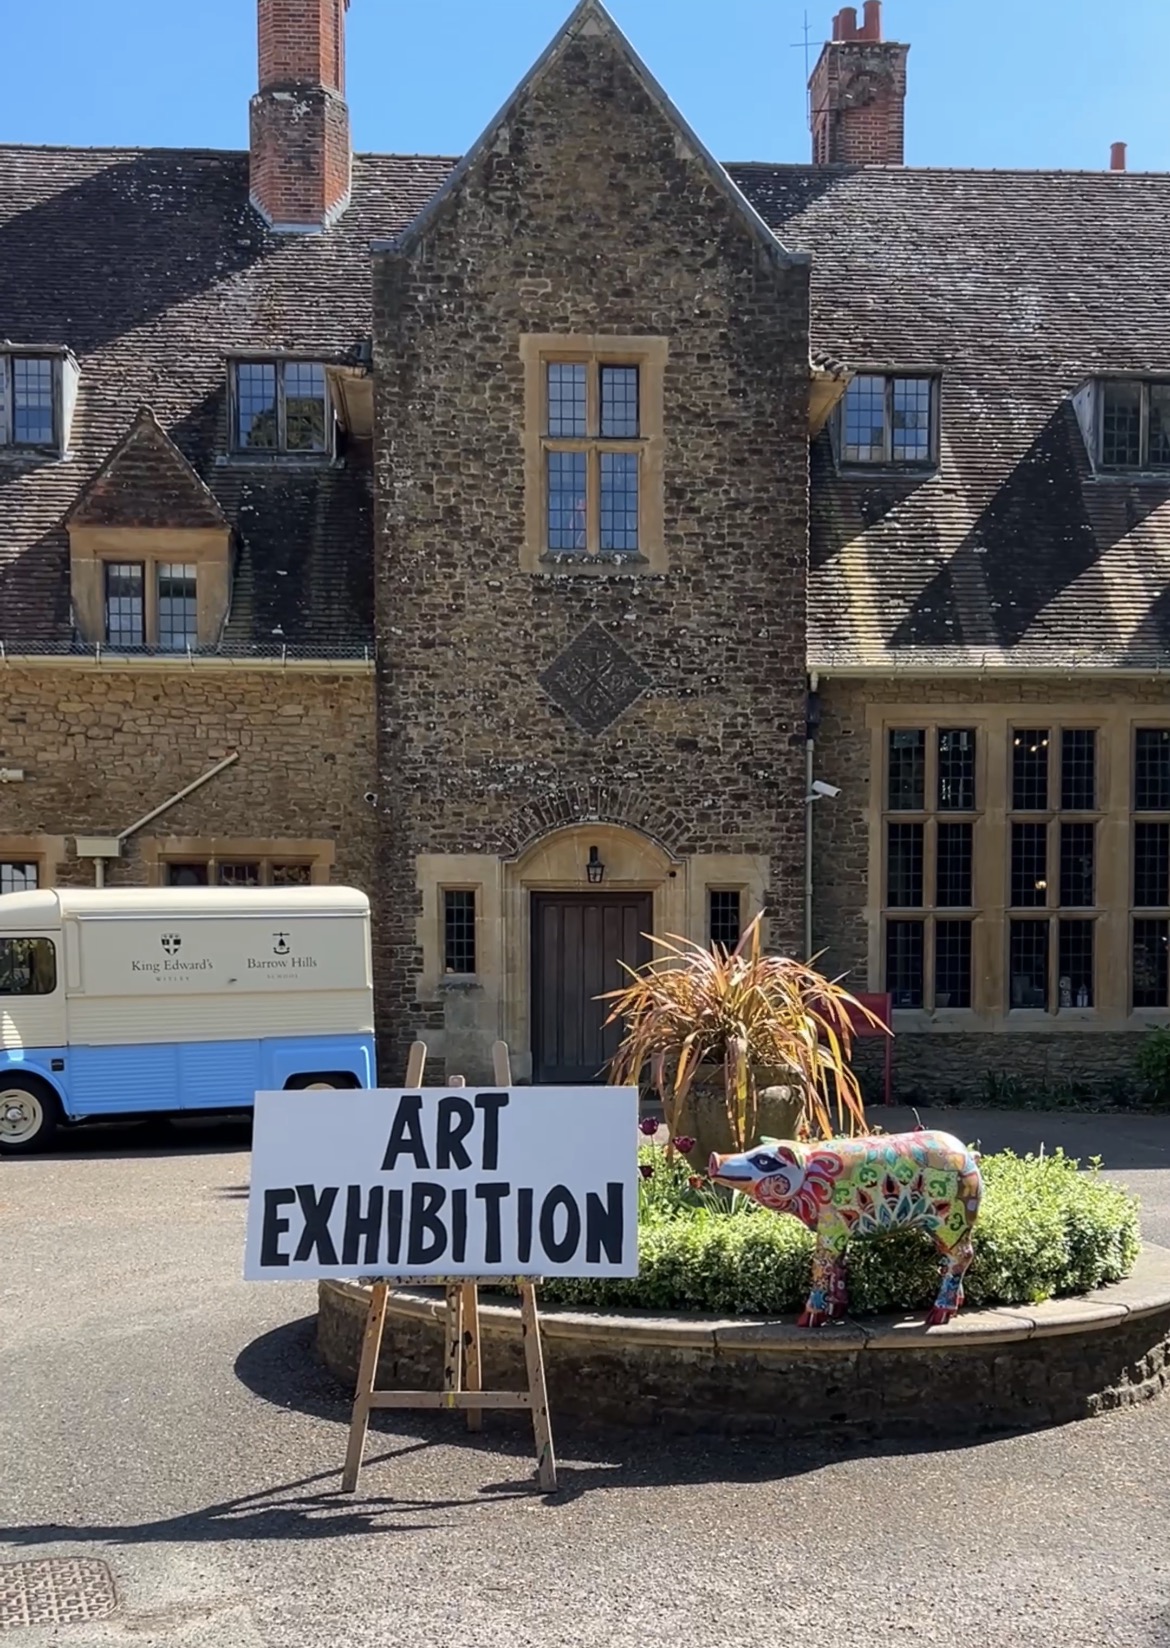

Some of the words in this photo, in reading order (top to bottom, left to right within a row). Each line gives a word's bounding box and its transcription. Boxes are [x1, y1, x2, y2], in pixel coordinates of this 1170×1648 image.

[131, 960, 160, 973] King
[164, 958, 213, 971] Edward's
[247, 957, 288, 969] Barrow
[291, 957, 318, 968] Hills
[380, 1092, 510, 1171] ART
[260, 1182, 624, 1267] EXHIBITION
